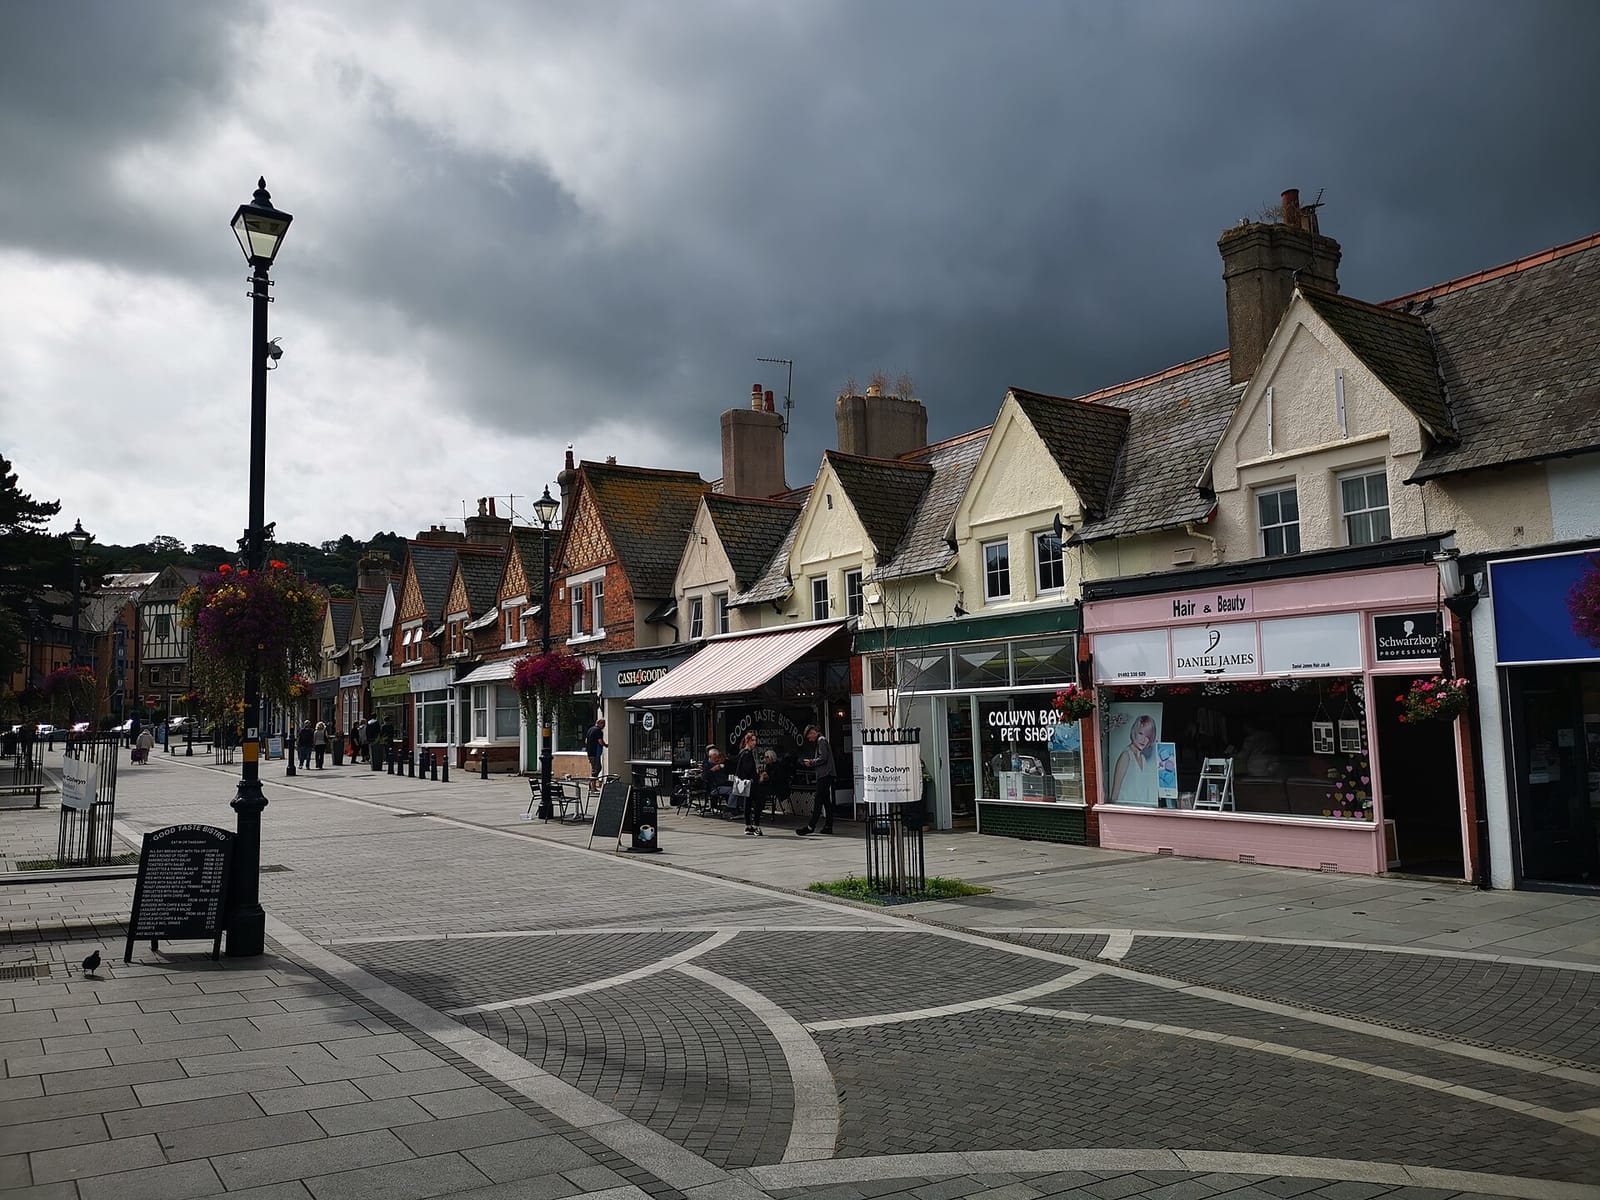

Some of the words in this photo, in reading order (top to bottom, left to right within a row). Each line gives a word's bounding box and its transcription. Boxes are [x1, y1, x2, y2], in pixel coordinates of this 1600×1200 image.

[1172, 600, 1196, 617] Hair
[1203, 605, 1212, 613] &
[1218, 594, 1246, 612] Beauty
[1379, 633, 1442, 648] Schwarzkop
[1177, 656, 1216, 668] DANIEL
[1218, 653, 1254, 667] JAMES
[989, 710, 1035, 726] COLWYN
[1040, 709, 1064, 725] BAY
[730, 714, 752, 744] GOOD
[754, 709, 776, 722] TASTE
[778, 712, 803, 746] BISTRO
[1001, 728, 1021, 742] PET
[1024, 727, 1054, 742] SHOP
[868, 775, 877, 783] Bay
[153, 828, 176, 840] GOOD
[202, 827, 226, 840] BISTRO
